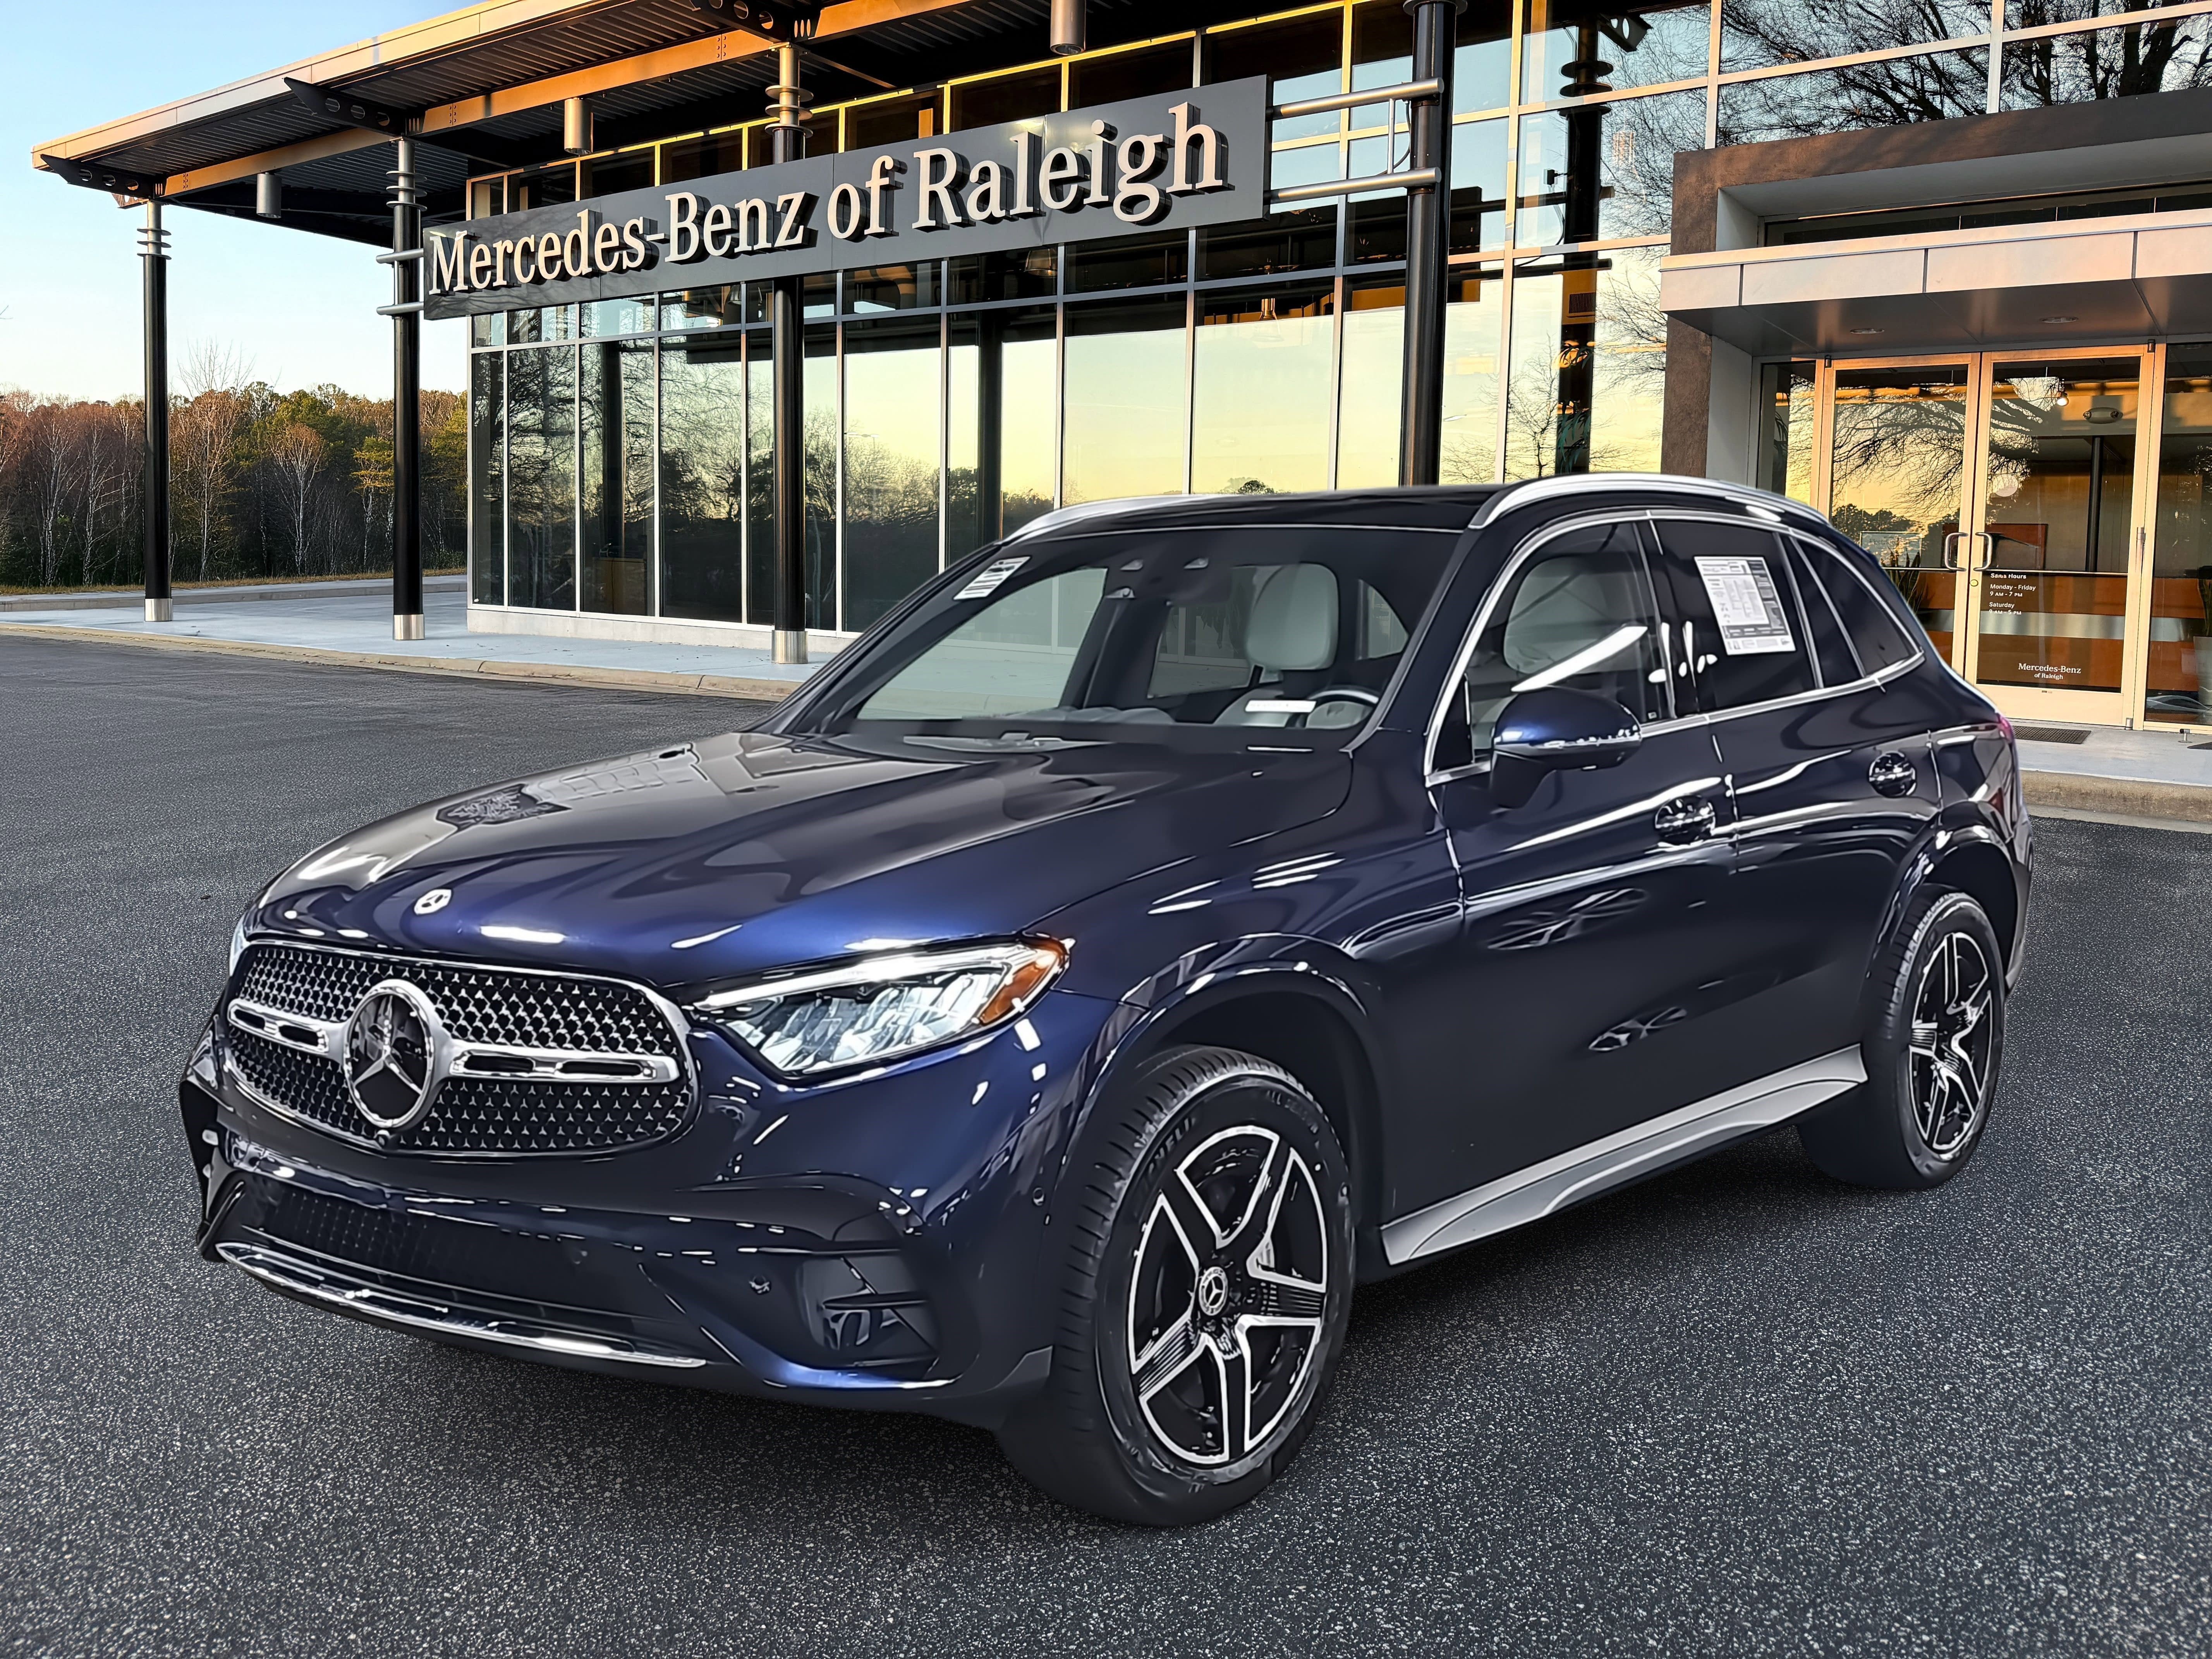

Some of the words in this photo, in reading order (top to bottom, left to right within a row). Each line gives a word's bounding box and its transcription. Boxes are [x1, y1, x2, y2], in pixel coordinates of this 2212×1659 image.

[428, 191, 808, 295] Mercedes-Benz
[827, 155, 895, 240] of
[912, 101, 1224, 222] Raleigh
[2018, 663, 2081, 674] Mercedes-Benz
